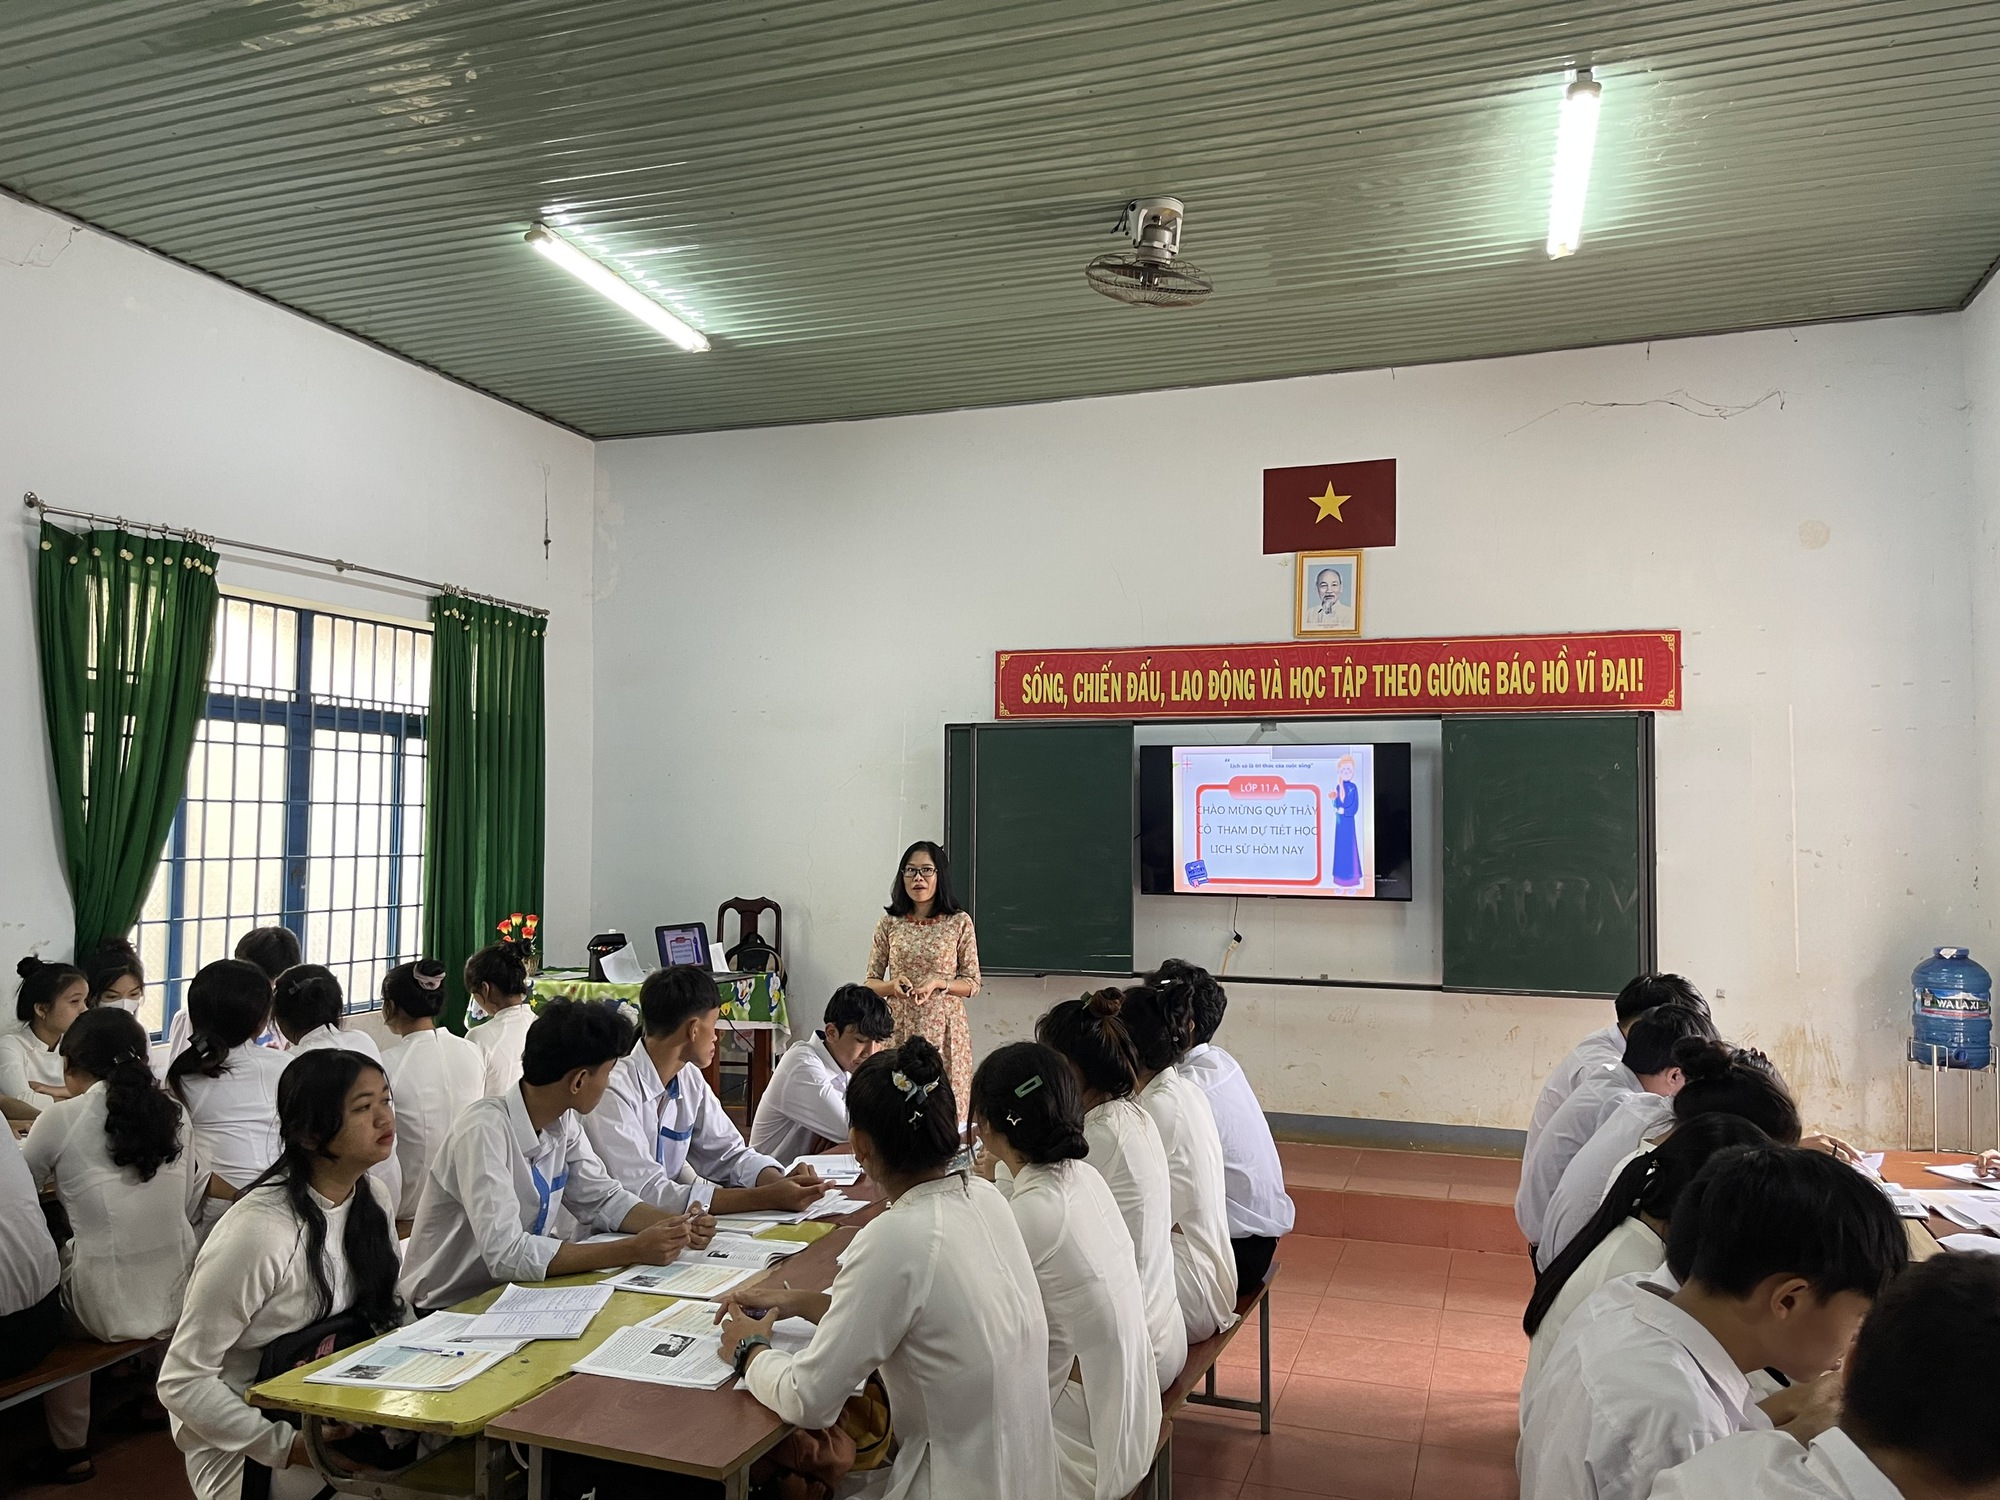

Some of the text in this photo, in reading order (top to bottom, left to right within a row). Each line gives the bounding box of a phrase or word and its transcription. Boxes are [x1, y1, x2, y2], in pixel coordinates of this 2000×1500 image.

[1021, 645, 1644, 709] SỐNG, CHIẾN ĐẤU, LAO ĐỘNG VÀ HỌC TẬP THEO GƯƠNG BÁC HỒ VĨ ĐẠI!
[1240, 782, 1280, 792] LỚP 11 A
[1196, 804, 1225, 815] CHÀO
[1228, 804, 1262, 815] MỪNG
[1265, 804, 1288, 816] QUÝ
[1217, 825, 1248, 834] THAM
[1251, 825, 1268, 836] DỰ
[1294, 826, 1318, 836] HỌC
[1210, 844, 1233, 855] LỊCH
[1282, 845, 1304, 855] NAY
